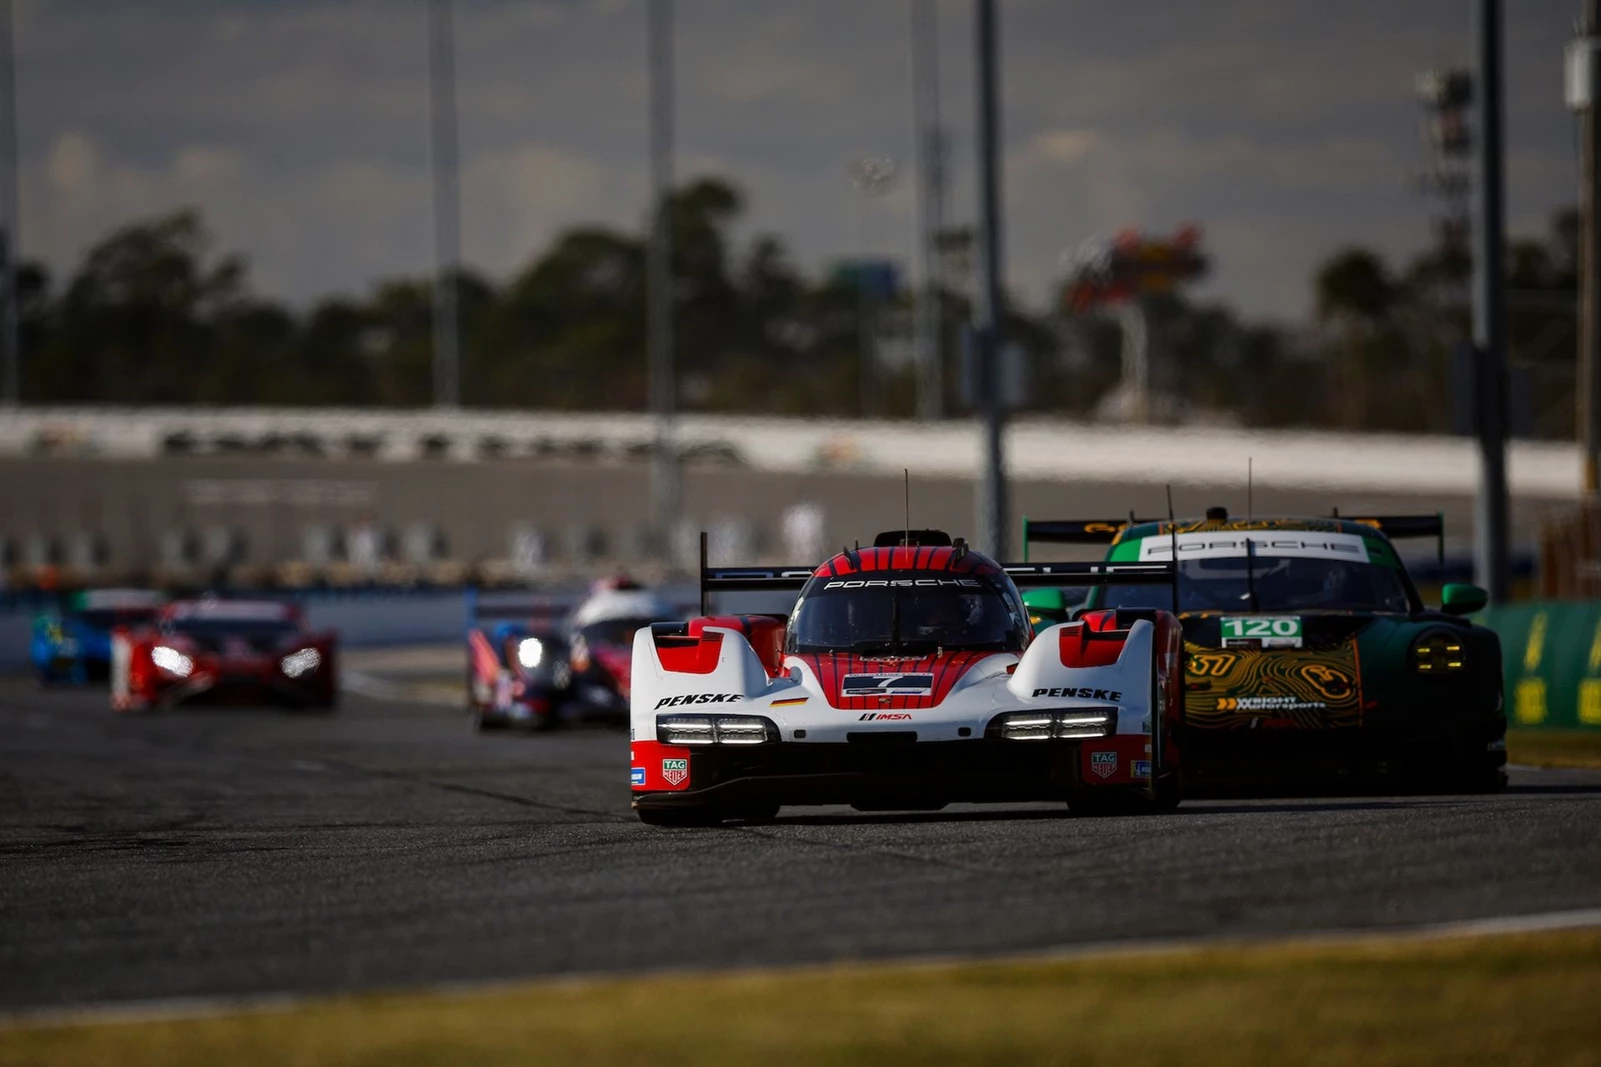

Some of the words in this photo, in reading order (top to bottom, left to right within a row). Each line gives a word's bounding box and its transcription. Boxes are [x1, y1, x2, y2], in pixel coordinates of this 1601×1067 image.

[1147, 541, 1359, 555] PORSCHE
[823, 579, 982, 590] PORSCHE
[1224, 620, 1299, 637] 120
[872, 675, 904, 688] 7
[654, 693, 745, 710] PENSKE
[1032, 687, 1122, 702] PENSKE
[665, 760, 685, 769] TAG
[1094, 754, 1115, 762] TAG
[663, 770, 687, 784] HEUER
[1093, 763, 1117, 777] HEUER
